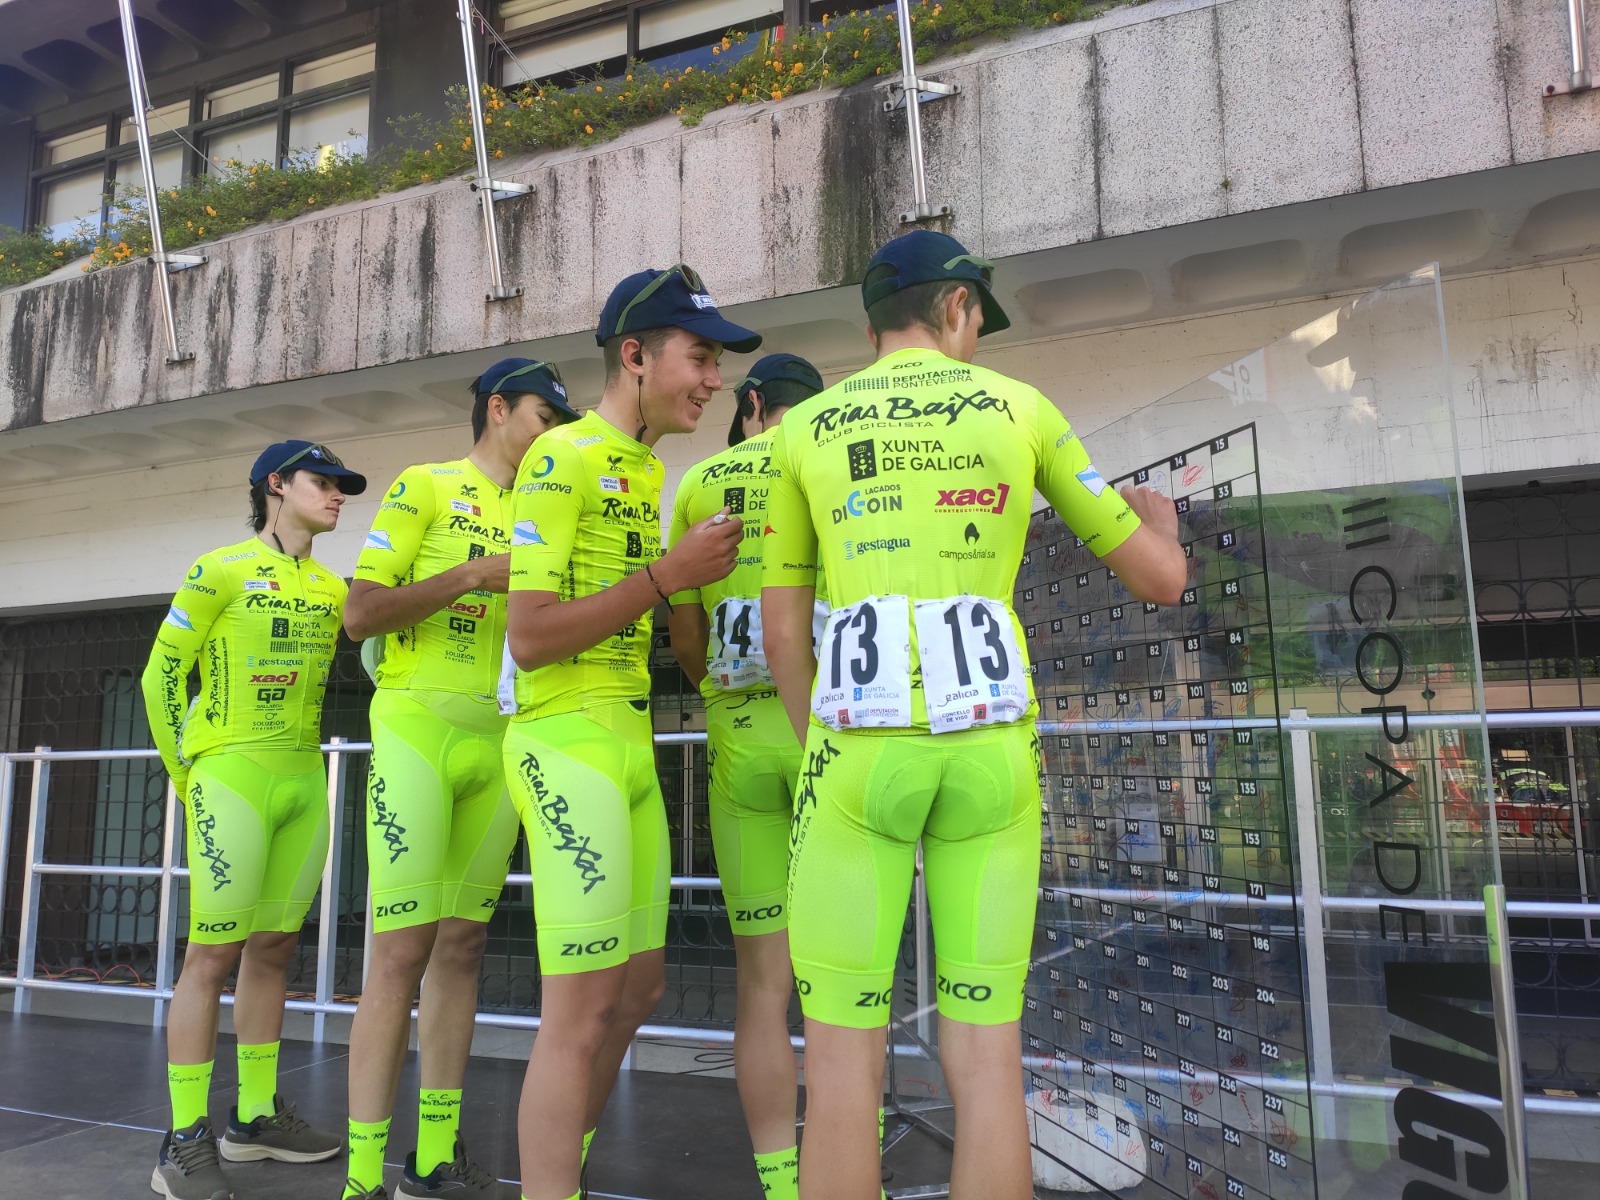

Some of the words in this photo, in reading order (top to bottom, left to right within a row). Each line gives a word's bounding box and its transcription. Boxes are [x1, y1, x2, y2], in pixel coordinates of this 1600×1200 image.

[893, 369, 970, 382] DEPUTACIÓN
[893, 375, 973, 388] PONTEVEDRA
[818, 428, 852, 447] CLUB
[860, 422, 934, 430] CICLISTA
[882, 440, 944, 453] XUNTA
[1215, 438, 1225, 450] 15
[882, 457, 905, 471] DE
[910, 454, 984, 471] GALICIA
[1175, 456, 1183, 467] 14
[1138, 471, 1146, 482] 13
[461, 491, 478, 499] ZICO
[865, 484, 900, 494] LACADOS
[1218, 485, 1229, 498] 33
[749, 501, 765, 510] DE
[1178, 501, 1187, 512] 32
[1223, 534, 1232, 545] 51
[857, 538, 910, 555] gestagua
[222, 552, 258, 563] ABANCA
[1079, 576, 1087, 585] 44
[1226, 582, 1237, 594] 66
[1184, 592, 1194, 603] 65
[1113, 608, 1121, 618] 63
[716, 603, 752, 658] 14
[944, 602, 1009, 686] 13
[1230, 632, 1241, 644] 84
[831, 602, 879, 689] 13
[1150, 645, 1159, 655] 82
[1188, 639, 1198, 650] 83
[1117, 651, 1123, 660] 81
[1190, 686, 1203, 697] 101
[1231, 681, 1247, 693] 102
[1349, 565, 1415, 809] COPA
[937, 689, 979, 707] galicia
[1119, 693, 1127, 703] 96
[1153, 690, 1162, 700] 97
[942, 710, 970, 718] CONCELLO
[1121, 736, 1131, 746] 114
[1156, 735, 1167, 745] 115
[1194, 733, 1206, 744] 116
[1237, 732, 1250, 743] 117
[1124, 779, 1135, 789] 132
[1159, 780, 1171, 790] 133
[1197, 781, 1211, 792] 134
[1240, 782, 1255, 794] 135
[518, 770, 530, 793] CLUB
[530, 795, 551, 839] CICLISTA
[1127, 822, 1138, 832] 147
[1163, 825, 1174, 836] 151
[1201, 829, 1215, 840] 152
[1244, 833, 1260, 845] 153
[792, 817, 811, 876] CICLISTA
[1130, 865, 1142, 876] 165
[1165, 870, 1178, 882] 166
[1205, 876, 1219, 888] 167
[1250, 883, 1263, 896] 171
[1373, 841, 1428, 946] DE
[376, 901, 418, 917] ZICO
[736, 905, 782, 921] ZICO
[1133, 910, 1145, 922] 183
[197, 922, 236, 932] ZICO
[1169, 918, 1182, 931] 184
[1209, 927, 1223, 940] 185
[560, 937, 619, 956] ZICO
[1253, 937, 1269, 951] 186
[1137, 955, 1149, 967] 201
[1172, 965, 1187, 978] 202
[937, 975, 991, 1001] ZICO
[1212, 976, 1229, 990] 203
[1257, 989, 1275, 1004] 204
[1141, 1001, 1152, 1013] 216
[1177, 1013, 1189, 1026] 217
[1217, 1027, 1231, 1042] 221
[1144, 1045, 1157, 1059] 234
[1261, 1042, 1279, 1059] 222
[1180, 1060, 1195, 1075] 235
[1220, 1076, 1236, 1092] 236
[1384, 961, 1509, 1200] VIG
[1147, 1092, 1160, 1107] 252
[1265, 1094, 1282, 1111] 237
[1184, 1109, 1198, 1125] 253
[1224, 1128, 1240, 1145] 254
[1269, 1149, 1286, 1167] 255
[1188, 1158, 1200, 1174] 271
[1228, 1179, 1243, 1197] 272
